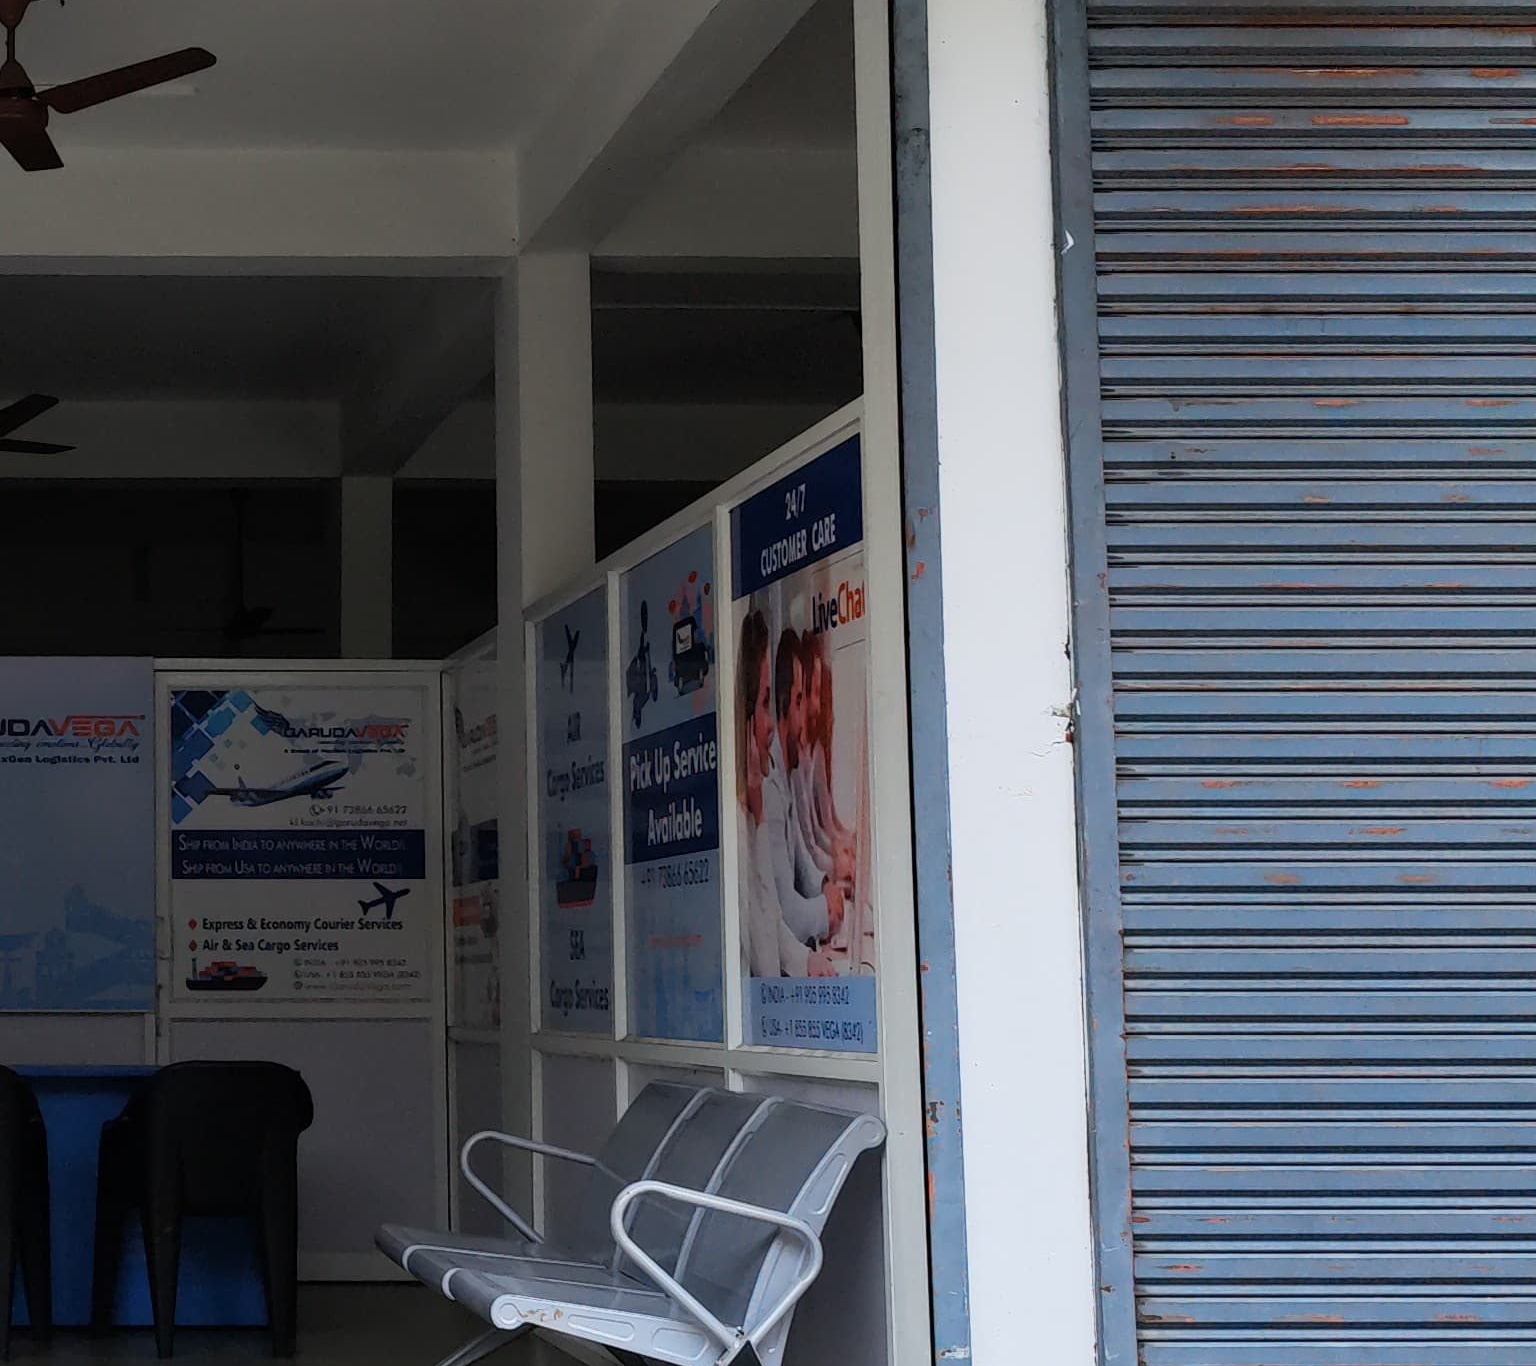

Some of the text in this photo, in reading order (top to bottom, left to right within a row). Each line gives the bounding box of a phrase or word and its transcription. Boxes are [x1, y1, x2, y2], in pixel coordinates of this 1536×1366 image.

[784, 483, 807, 521] 24/7
[760, 513, 837, 577] CUSTOMER CARE
[571, 755, 605, 791] Services
[629, 732, 718, 793] Pick Up Service
[647, 796, 703, 847] Available
[203, 918, 404, 933] Express & Economy Courier Services
[202, 938, 339, 954] Air & Sea Cargo Services
[550, 973, 610, 1016] Cargo Services
